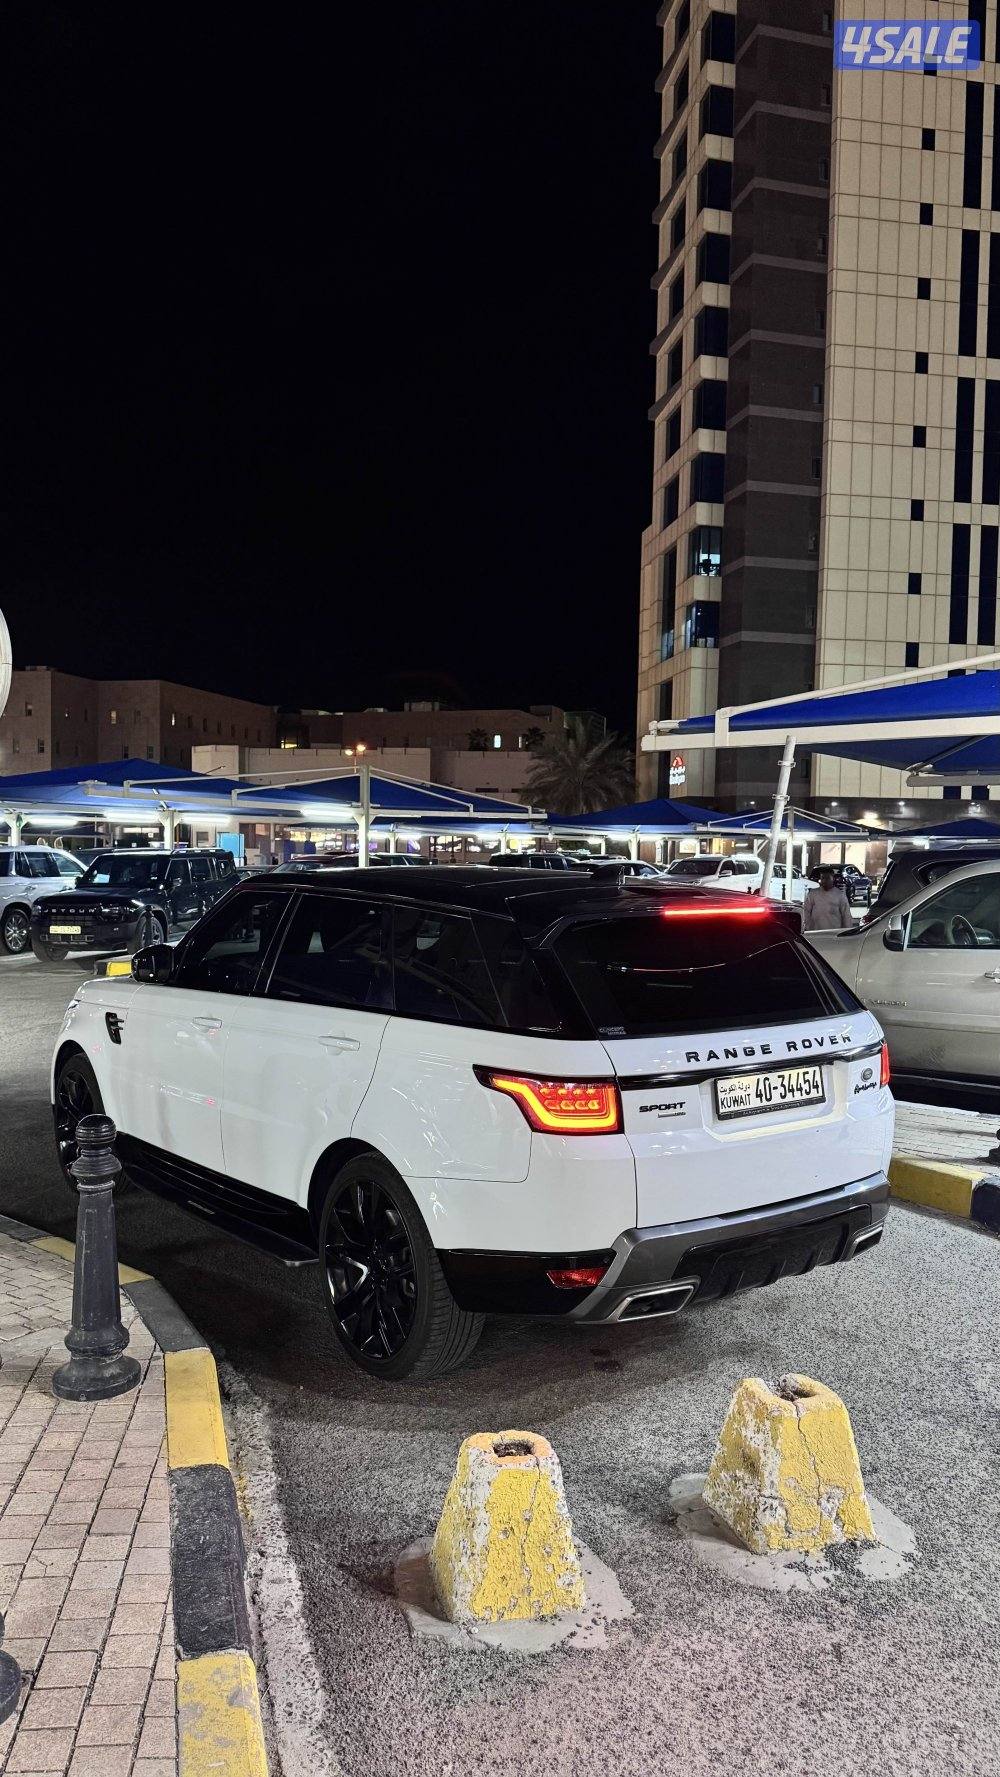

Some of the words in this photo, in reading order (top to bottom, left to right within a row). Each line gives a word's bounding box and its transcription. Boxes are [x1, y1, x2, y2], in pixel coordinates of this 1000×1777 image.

[685, 1044, 773, 1063] RANGE
[785, 1033, 852, 1052] ROVER
[755, 1070, 820, 1104] 40-34454
[639, 1101, 686, 1113] SPORT
[720, 1094, 751, 1110] KUWAIT
